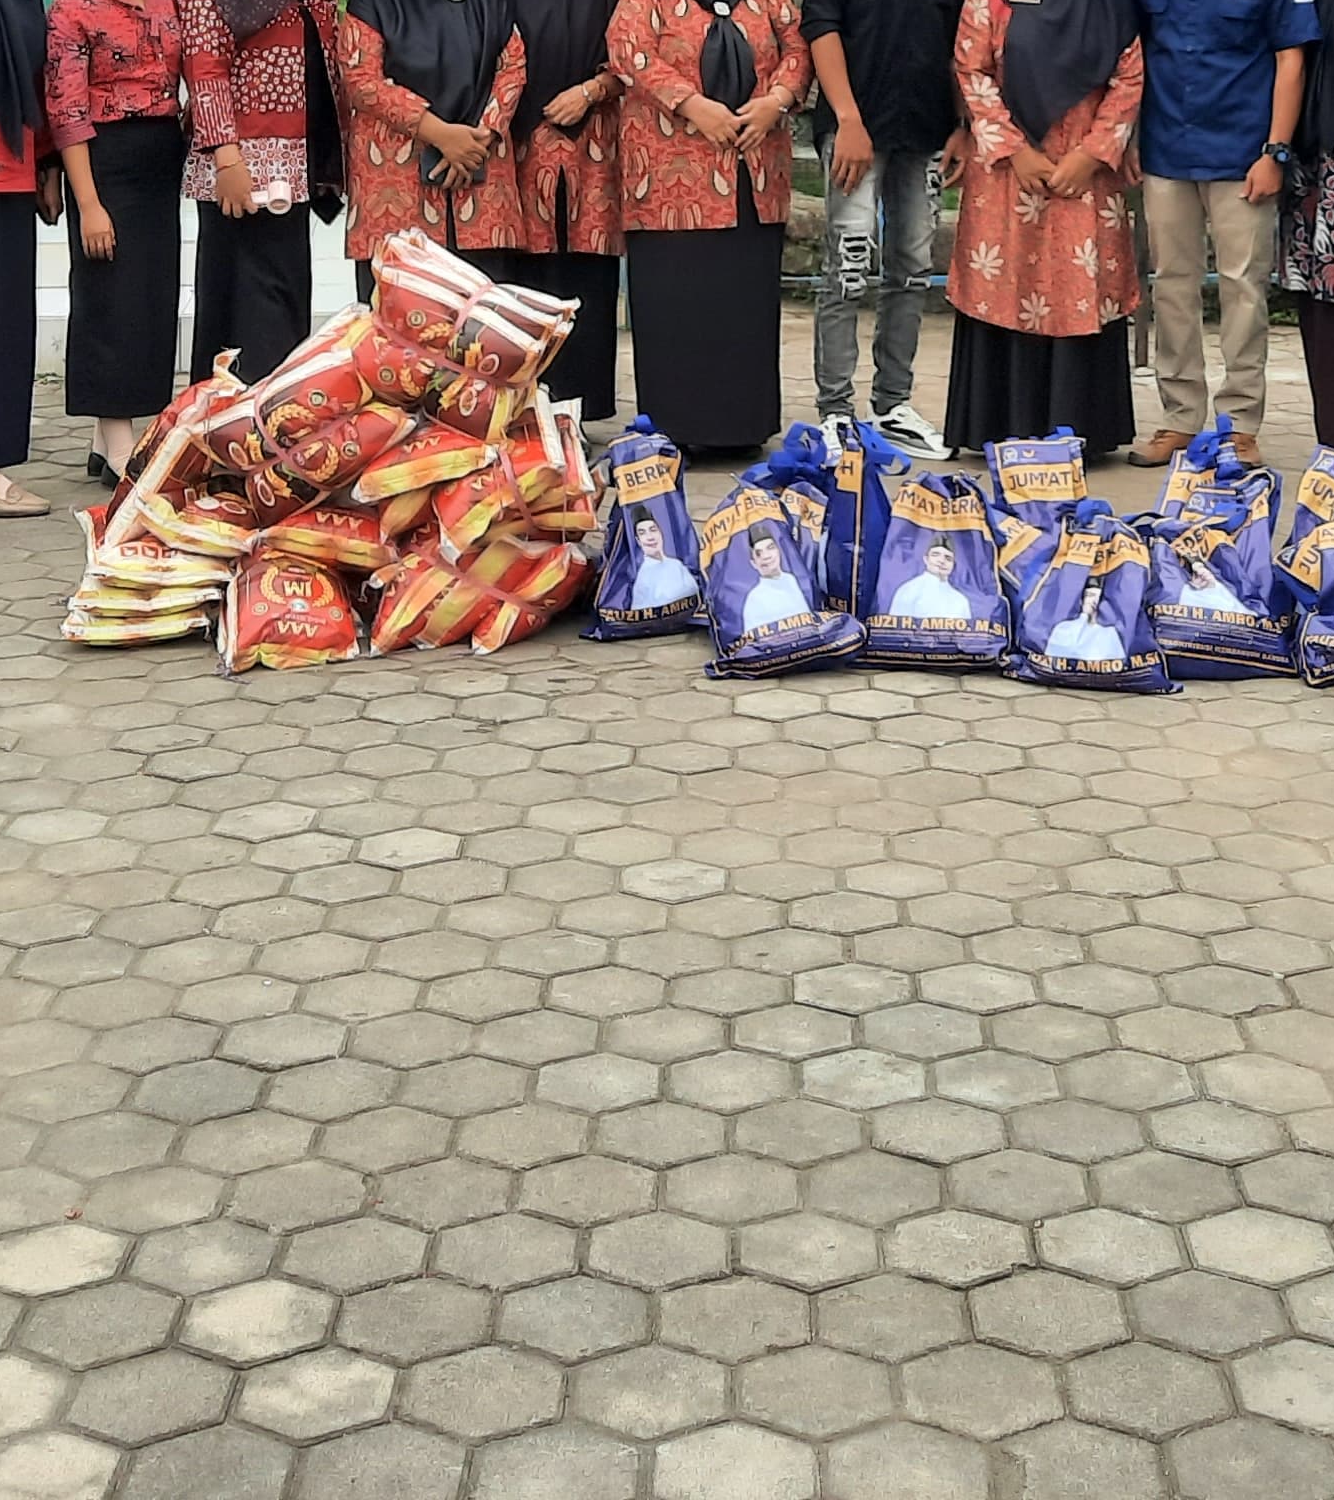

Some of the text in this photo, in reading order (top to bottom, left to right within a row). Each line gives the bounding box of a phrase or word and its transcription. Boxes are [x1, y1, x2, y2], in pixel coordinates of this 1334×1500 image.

[643, 606, 658, 620] H.
[1192, 607, 1208, 620] H.
[901, 617, 916, 629] H.
[1056, 656, 1072, 671] H.
